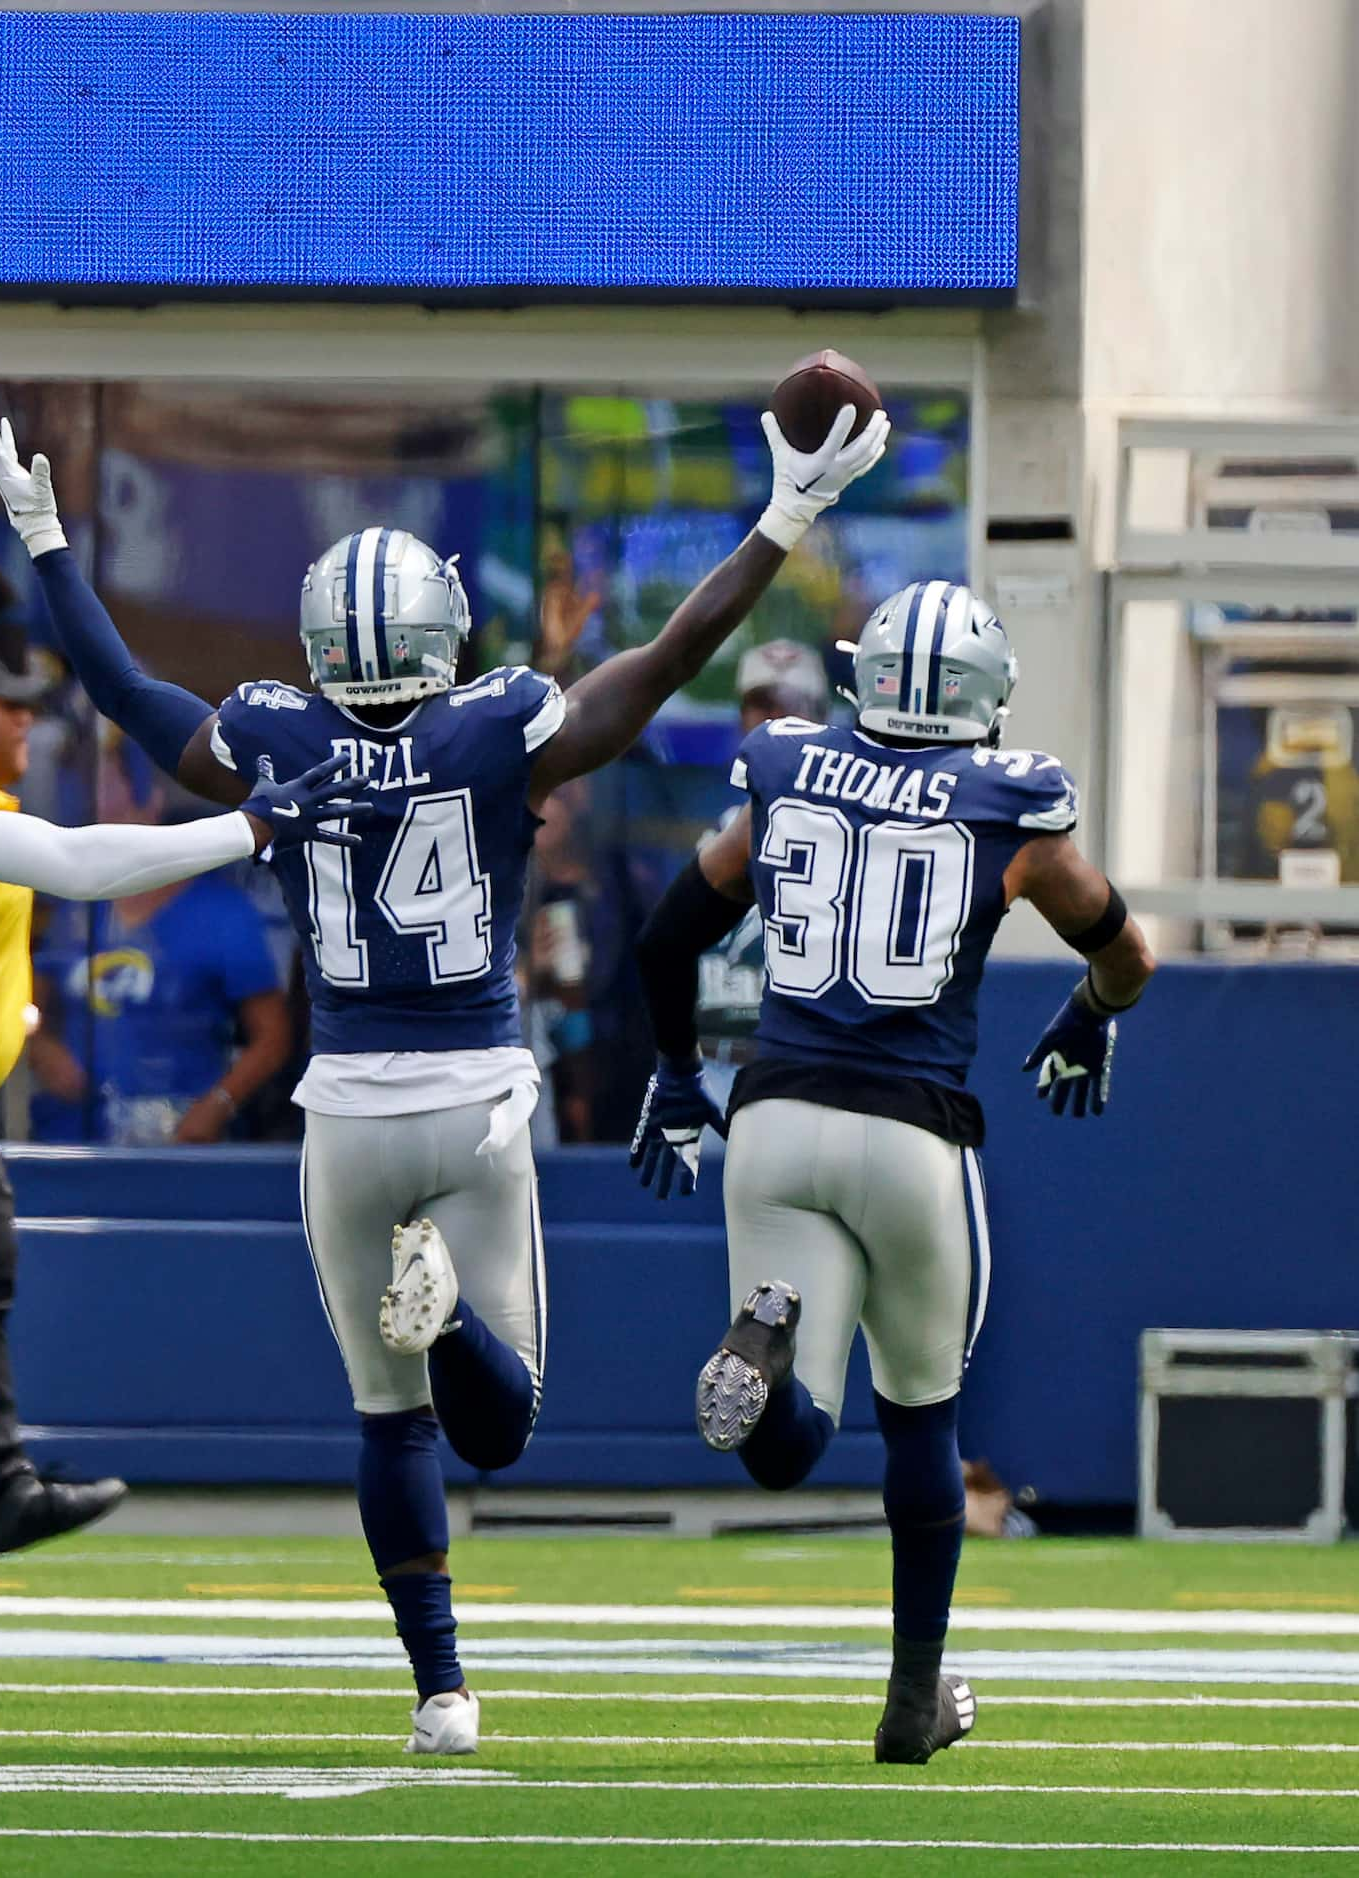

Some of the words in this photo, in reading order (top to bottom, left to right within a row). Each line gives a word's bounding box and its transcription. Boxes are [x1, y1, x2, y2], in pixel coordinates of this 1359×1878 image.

[793, 743, 958, 820] THOMAS
[303, 787, 493, 989] 14
[758, 796, 976, 1007] 30
